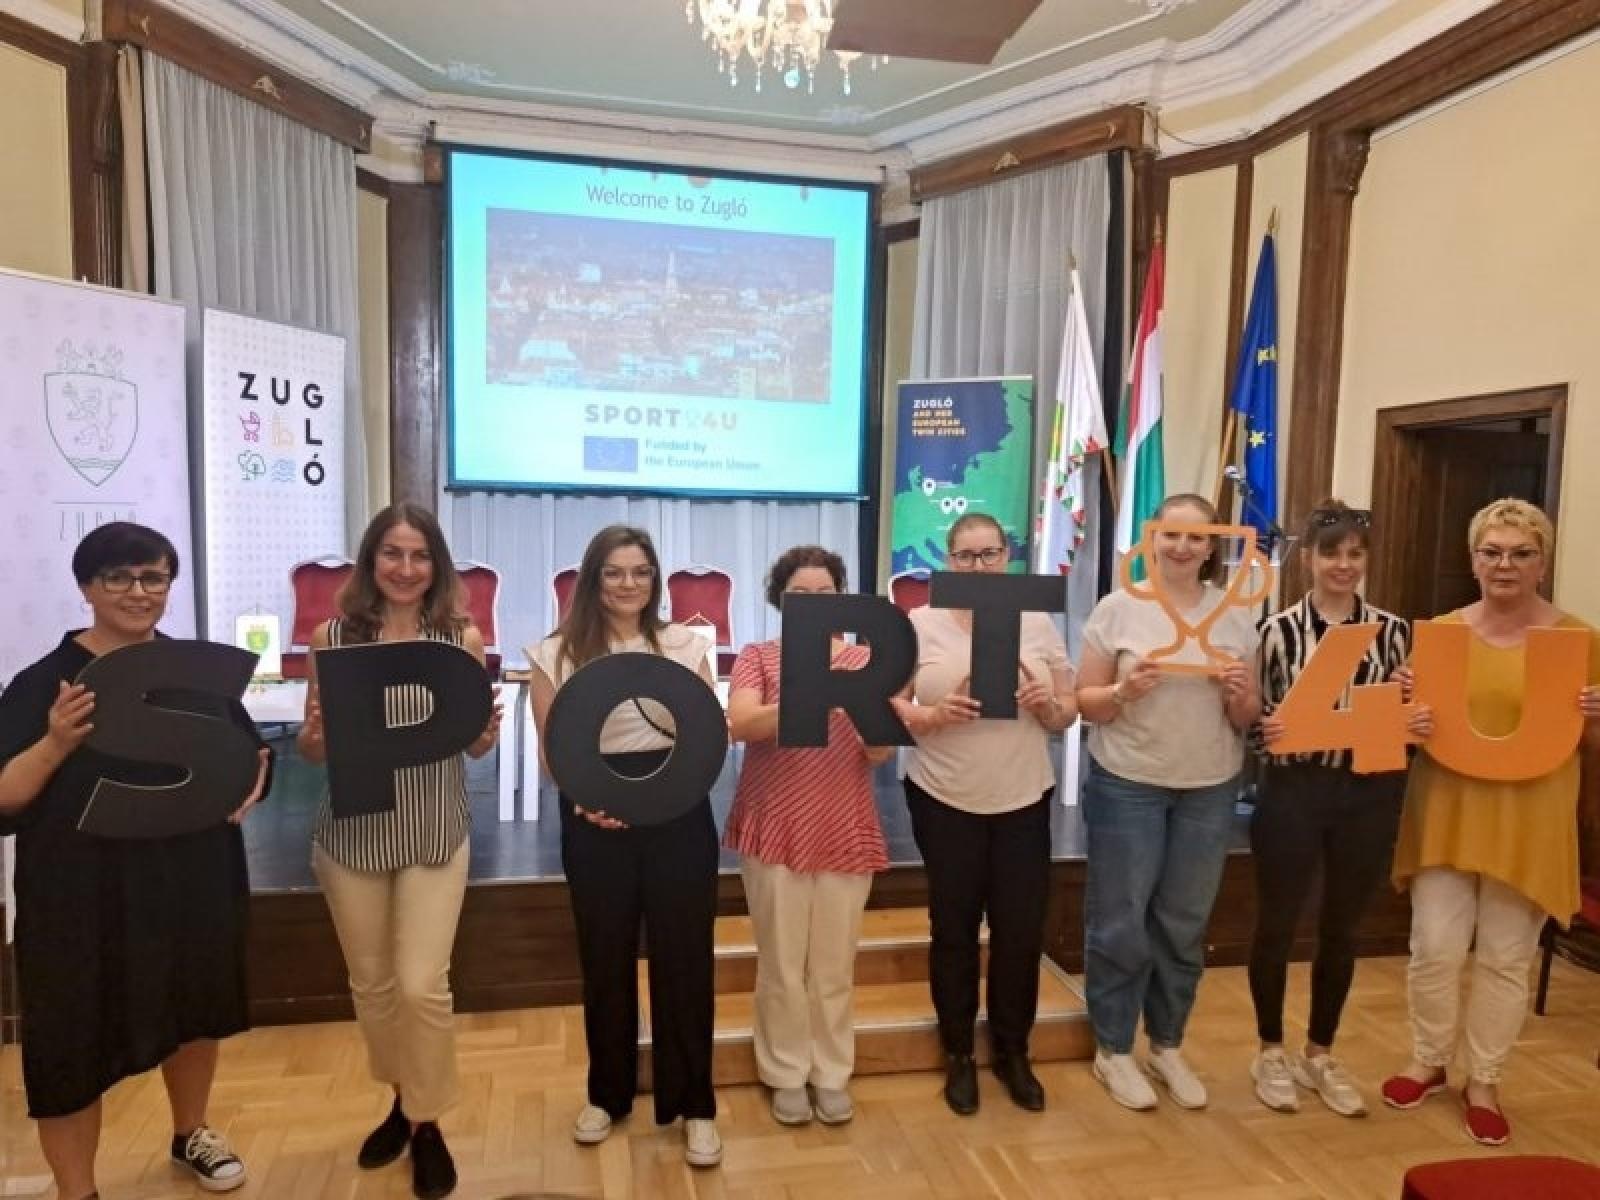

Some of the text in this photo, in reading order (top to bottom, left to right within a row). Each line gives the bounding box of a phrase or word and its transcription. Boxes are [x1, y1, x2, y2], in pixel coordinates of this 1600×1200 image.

[586, 183, 749, 221] Welcome to Zugló
[913, 395, 953, 409] ZUGLÓ
[584, 403, 681, 429] SPORT
[645, 438, 707, 454] Funded by
[644, 455, 761, 471] the European Union
